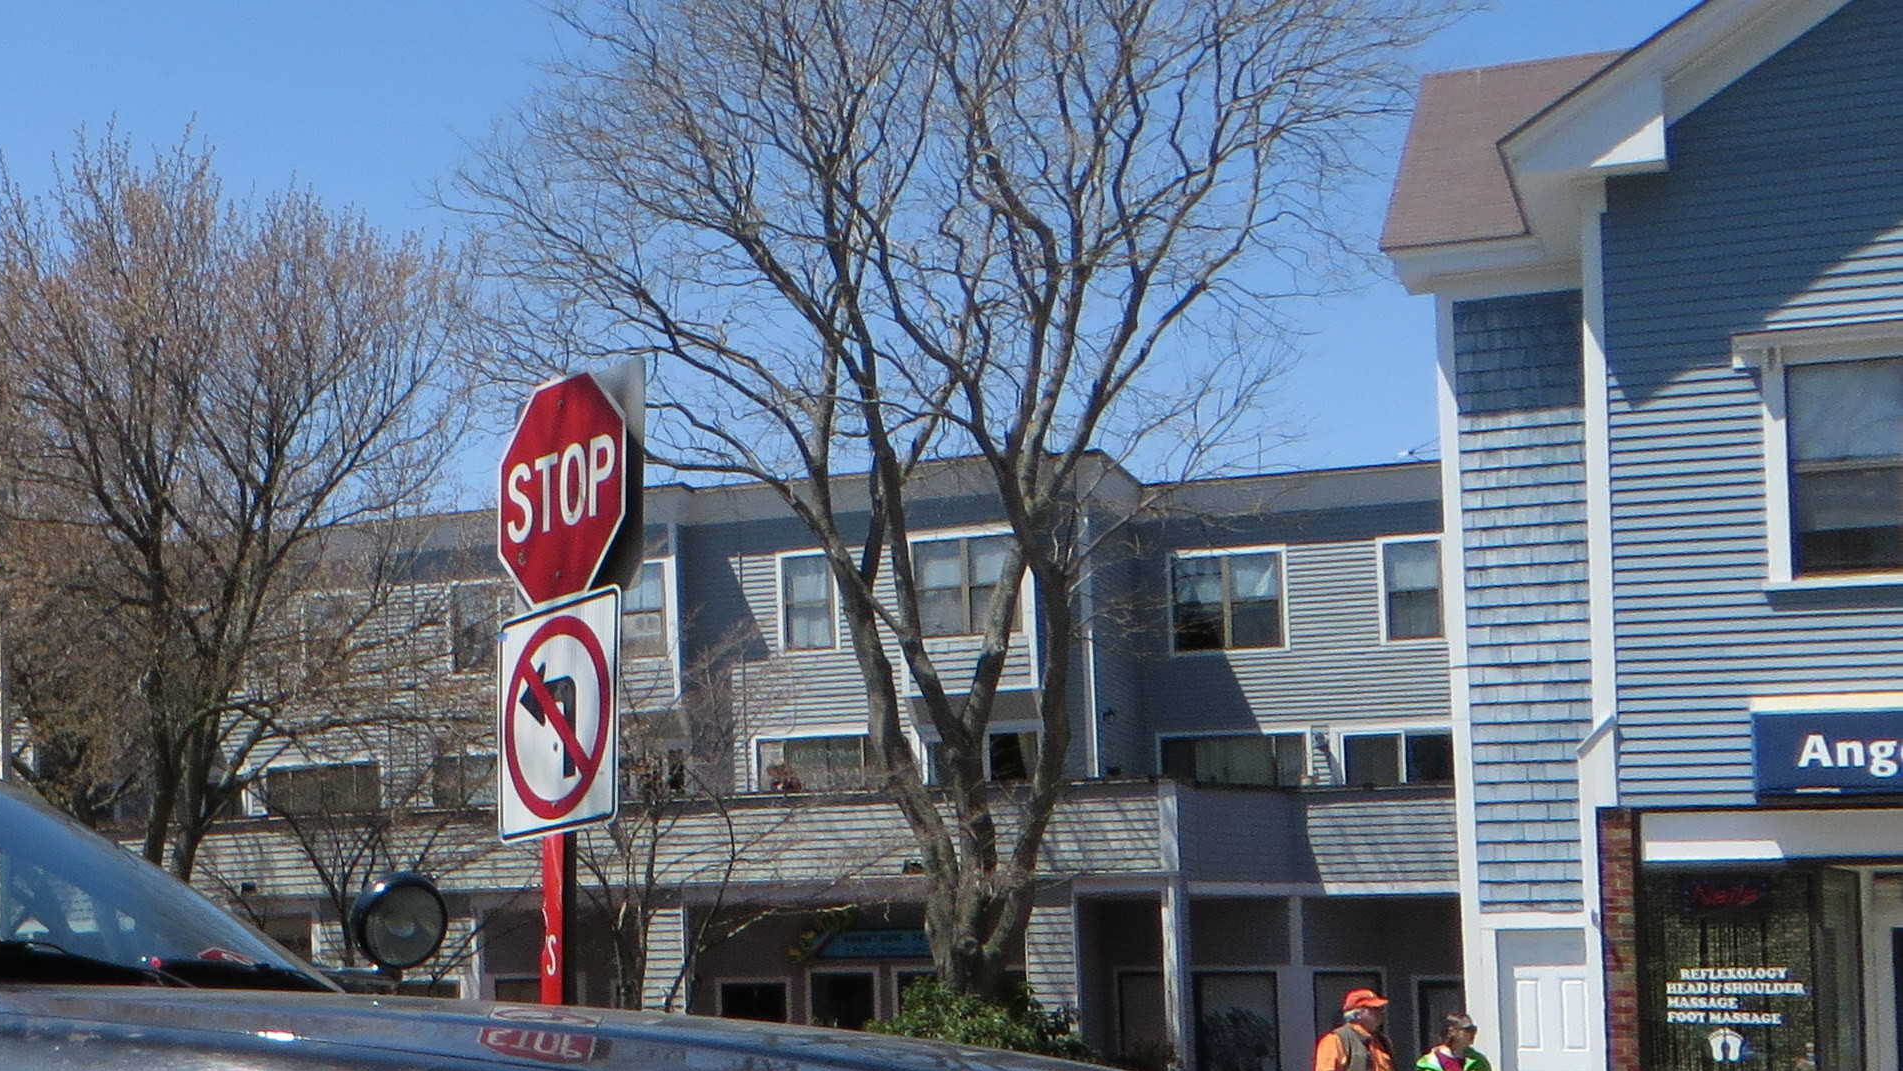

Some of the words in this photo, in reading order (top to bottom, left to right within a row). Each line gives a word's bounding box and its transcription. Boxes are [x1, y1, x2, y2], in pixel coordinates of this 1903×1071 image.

[507, 434, 615, 543] STOP
[1797, 733, 1903, 778] Ang
[1680, 967, 1787, 980] REFLEXOLOGY
[1666, 982, 1708, 994] HEAD
[1710, 982, 1721, 994] &
[1722, 982, 1805, 995] SHOULDER
[1666, 997, 1738, 1009] MASSAGE
[1666, 1011, 1706, 1023] FOOT
[1709, 1011, 1782, 1024] MASSAGE
